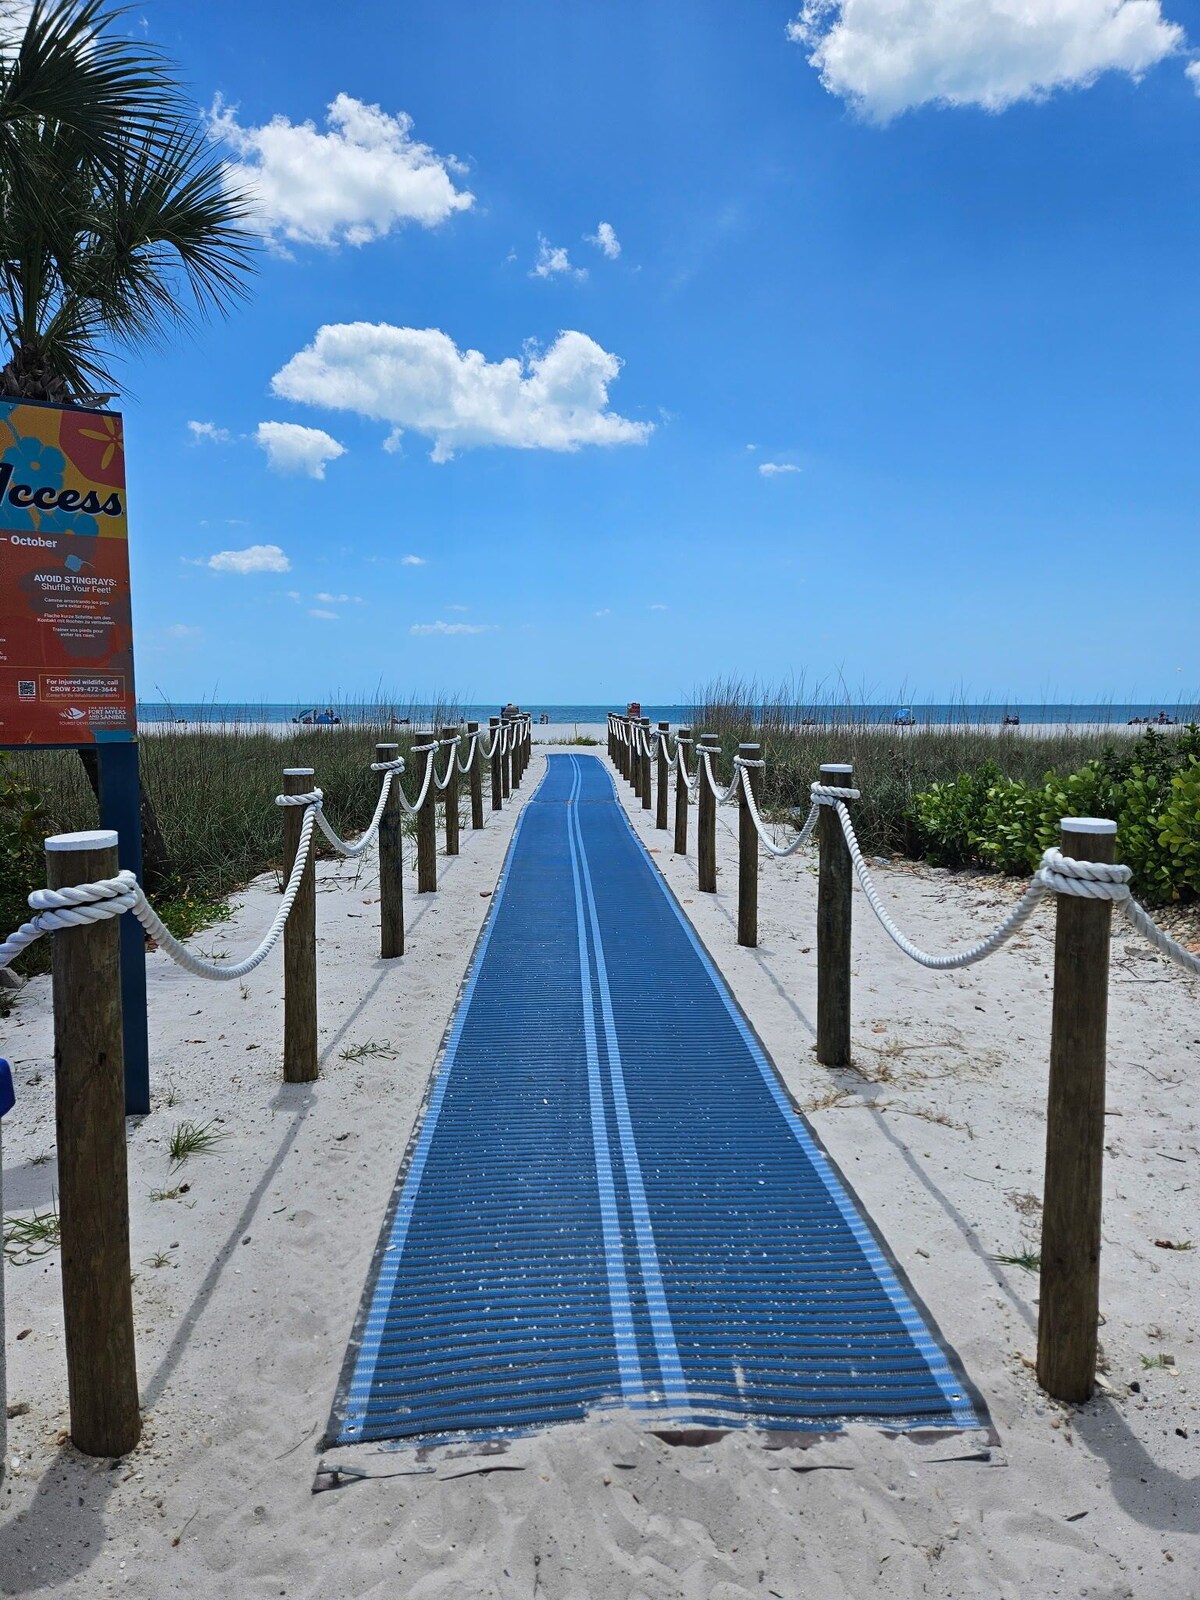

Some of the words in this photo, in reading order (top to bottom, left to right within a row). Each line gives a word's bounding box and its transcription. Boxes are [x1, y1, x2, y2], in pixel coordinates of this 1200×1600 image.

[11, 536, 57, 548] October
[34, 574, 62, 583] AVOID
[64, 576, 117, 586] STINGRAYS:
[41, 583, 71, 591] Shuffle
[72, 584, 90, 593] Your
[92, 586, 111, 594] Feet!
